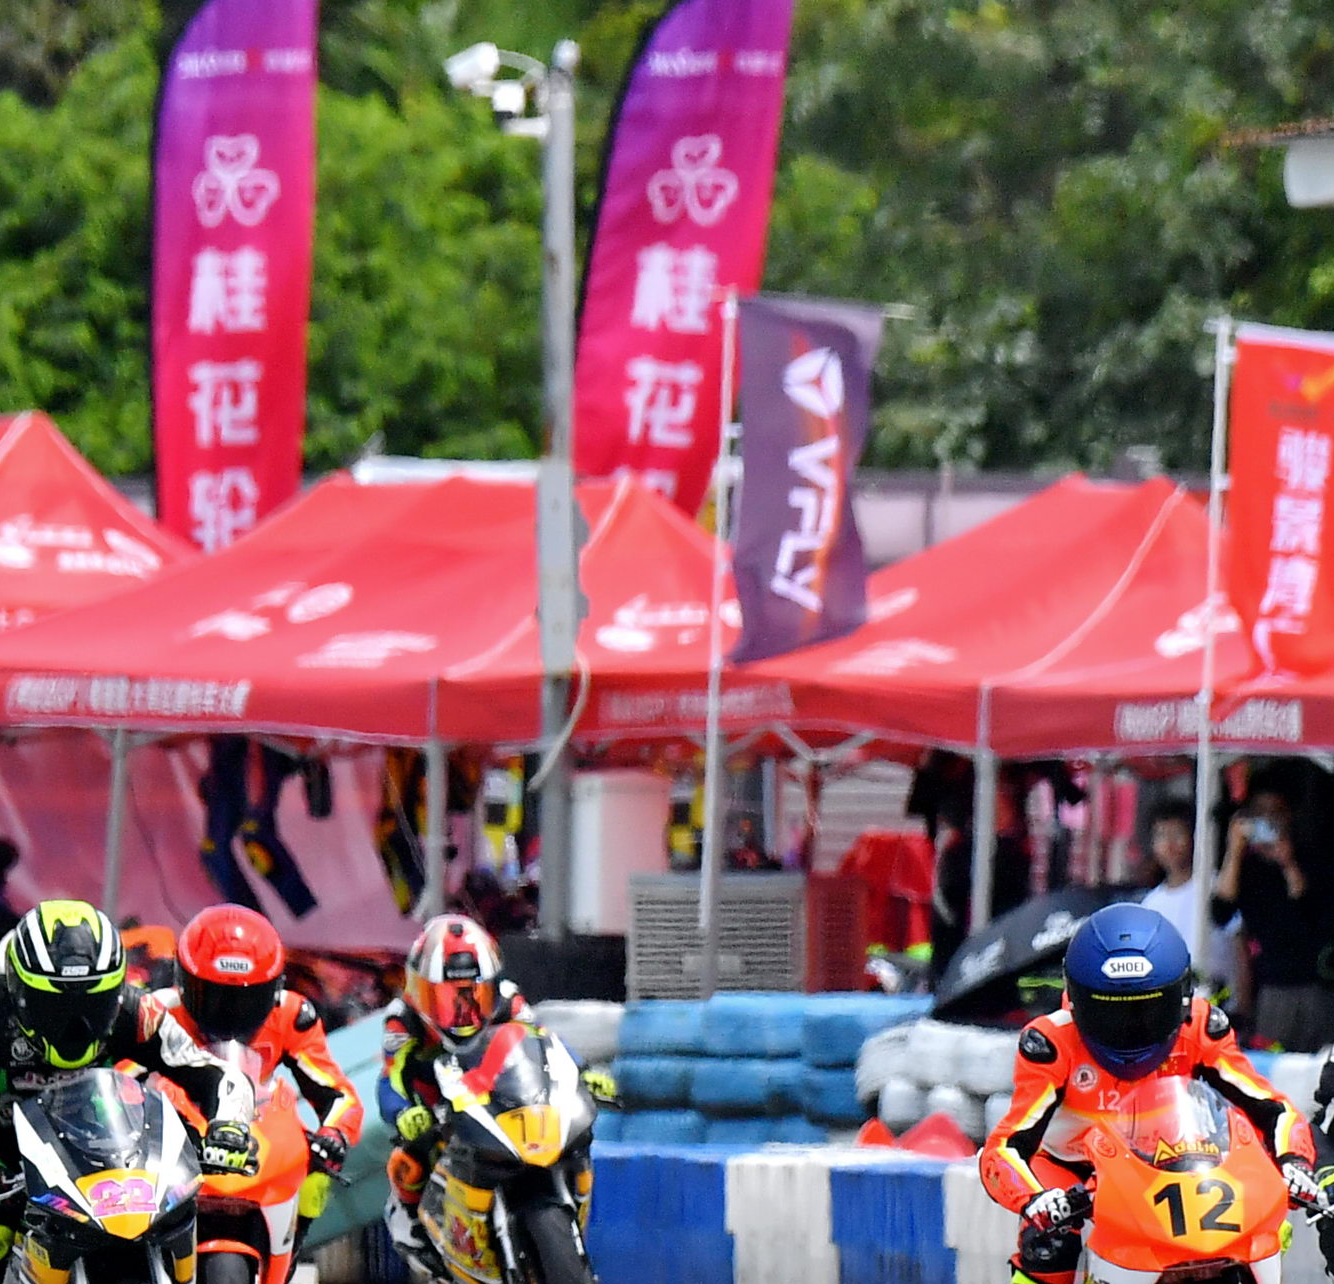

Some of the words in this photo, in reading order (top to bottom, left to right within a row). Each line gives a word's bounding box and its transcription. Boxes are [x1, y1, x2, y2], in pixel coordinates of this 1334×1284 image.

[624, 243, 718, 497] 桂花
[770, 434, 840, 613] VFLY
[219, 959, 249, 971] SHOEI
[1109, 962, 1145, 973] SHOEI
[1097, 1088, 1121, 1112] 12
[90, 1179, 159, 1218] 22
[1154, 1177, 1242, 1237] 12
